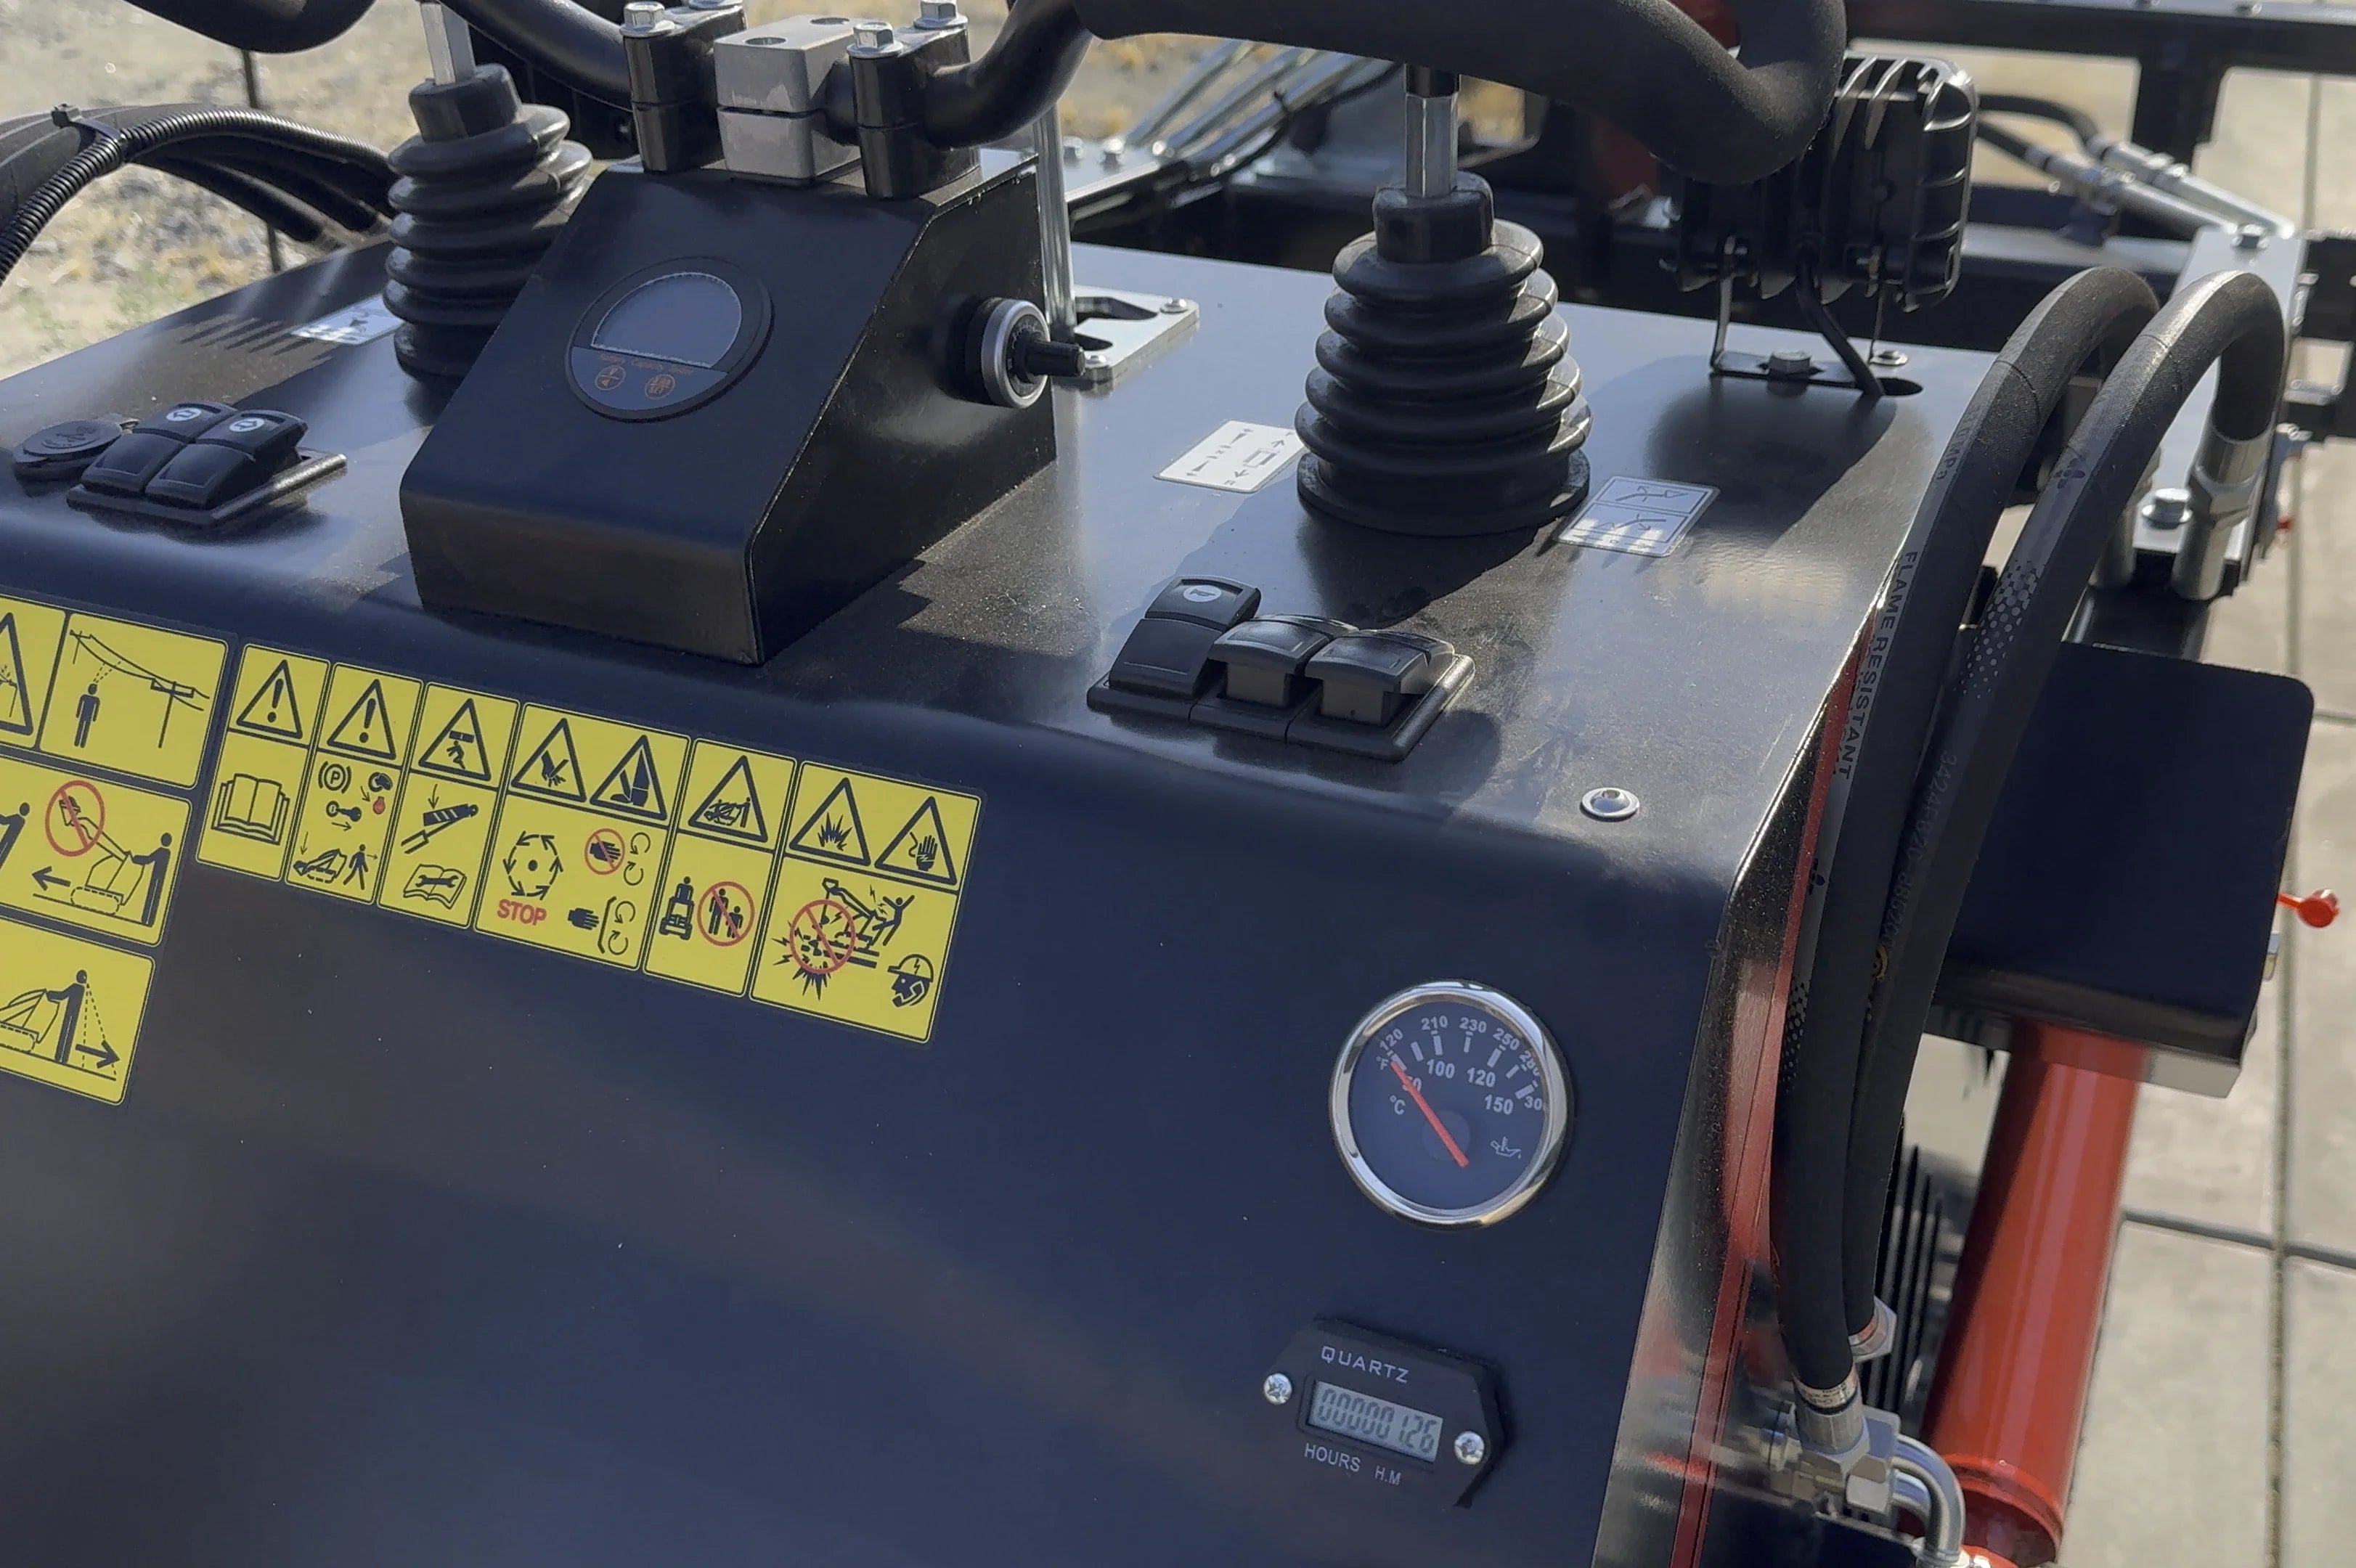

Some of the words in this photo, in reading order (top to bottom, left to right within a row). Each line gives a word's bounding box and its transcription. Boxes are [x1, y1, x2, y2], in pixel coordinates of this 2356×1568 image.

[1880, 551, 1917, 629] FLAME
[1838, 637, 1888, 779] RESISTANT
[497, 899, 547, 926] STOP
[1379, 1028, 1403, 1050] 120
[1421, 1015, 1448, 1030] 210
[1459, 1017, 1487, 1033] 230
[1493, 1028, 1520, 1050] 250
[1390, 1095, 1406, 1115] °C
[1427, 1059, 1455, 1079] 100
[1467, 1067, 1496, 1087] 120
[1485, 1094, 1514, 1115] 150
[1321, 1346, 1409, 1383] QUARTZ
[1318, 1388, 1438, 1453] 00000126
[1304, 1442, 1361, 1472] HOURS
[1374, 1465, 1402, 1485] H.M
